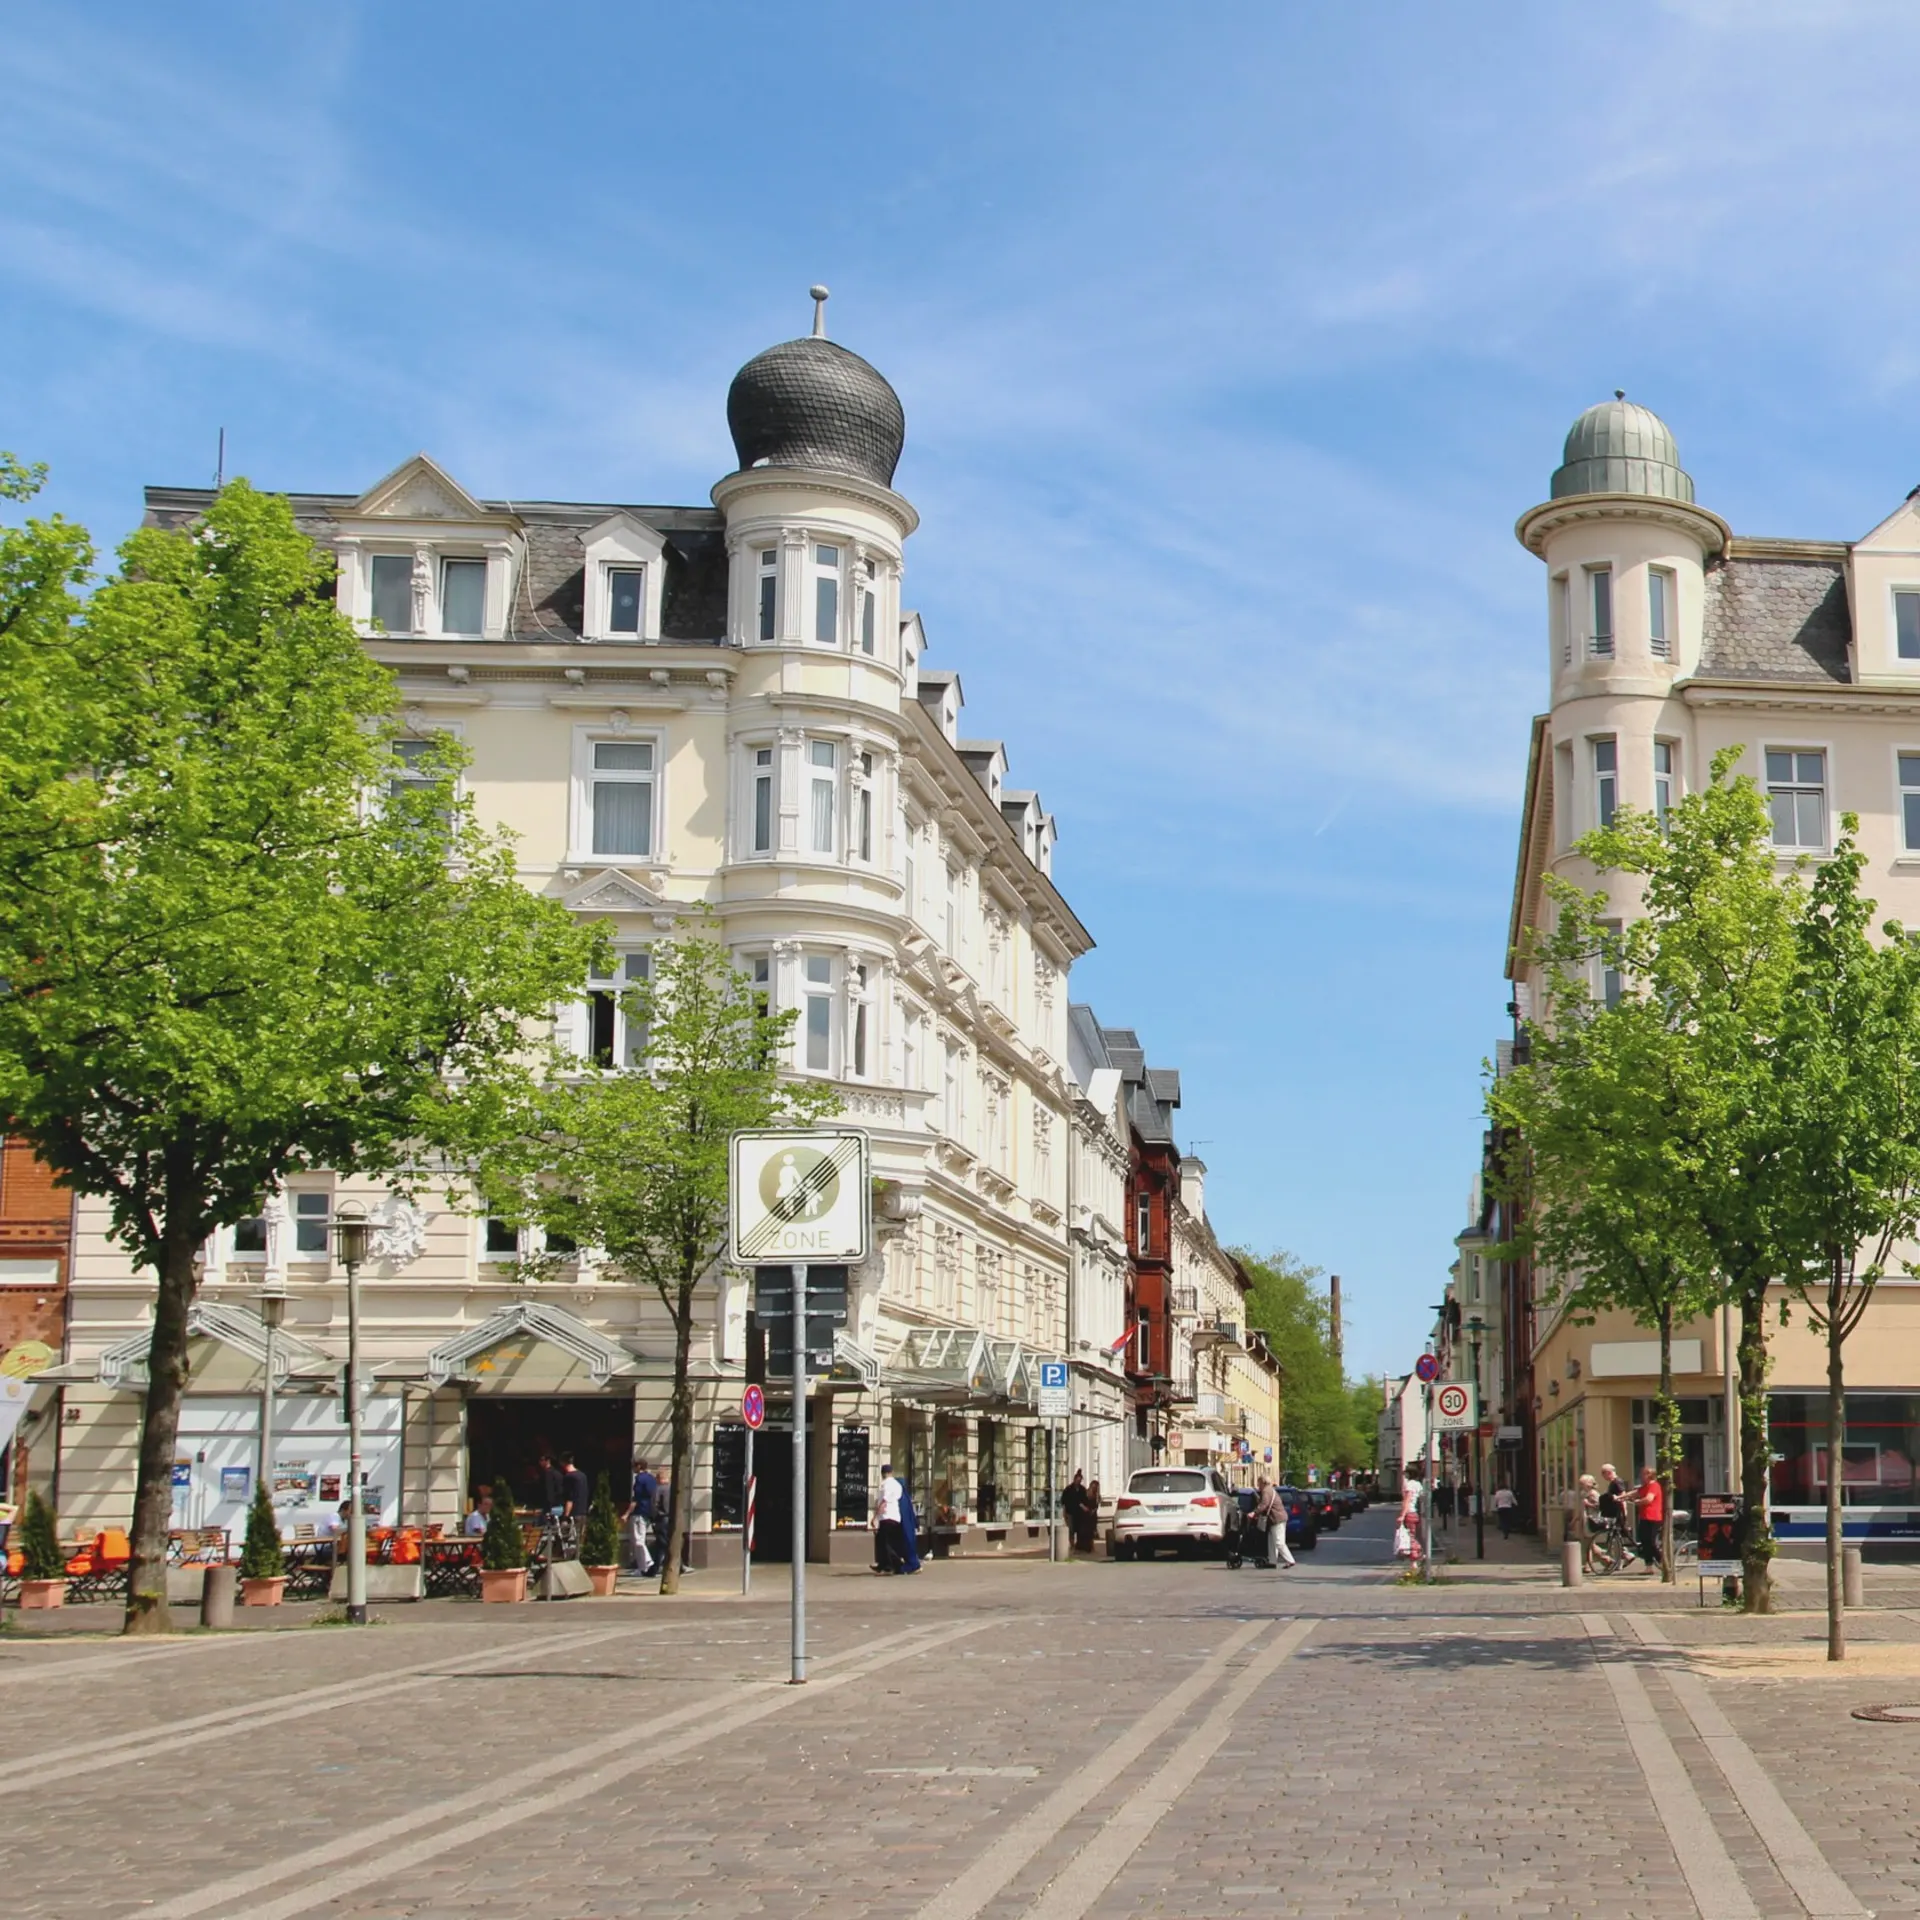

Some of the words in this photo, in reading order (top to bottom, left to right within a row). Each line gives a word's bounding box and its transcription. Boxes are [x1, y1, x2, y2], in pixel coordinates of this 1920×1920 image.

[770, 1230, 831, 1250] ZONE
[1046, 1366, 1061, 1385] P
[1445, 1394, 1461, 1408] 30
[1443, 1417, 1464, 1426] ZONE
